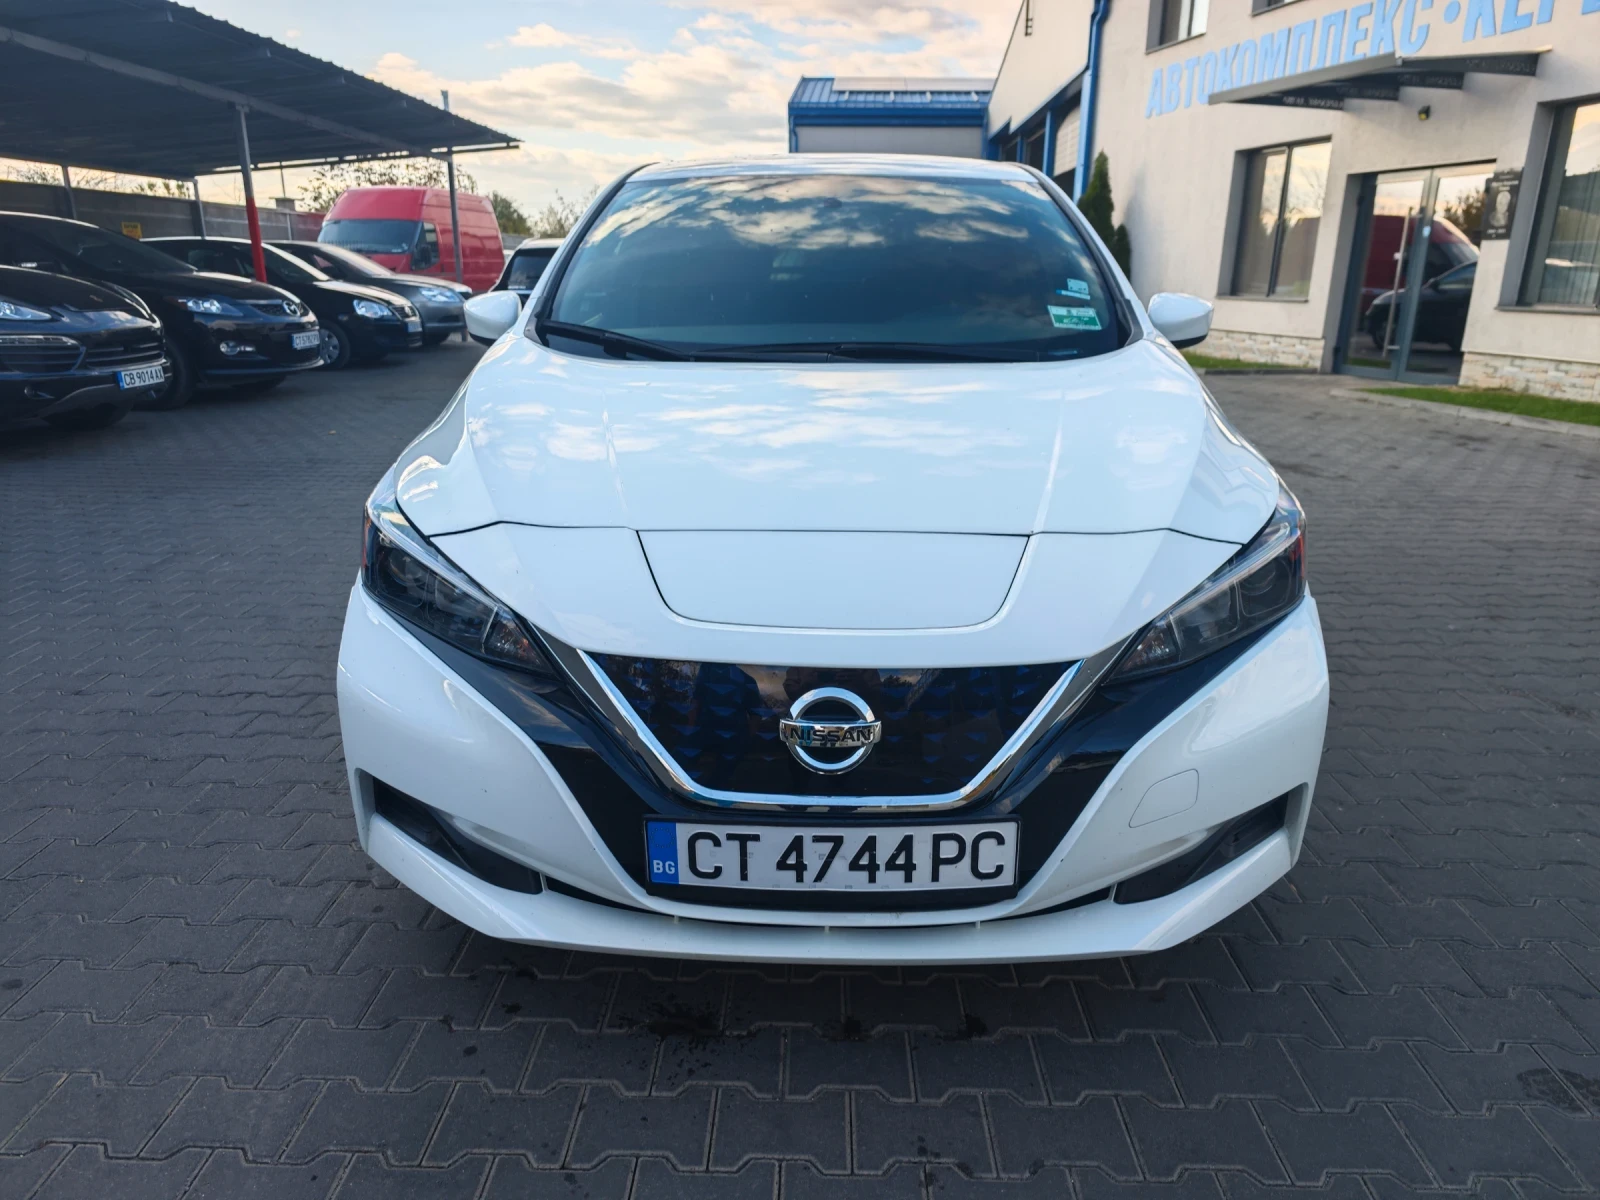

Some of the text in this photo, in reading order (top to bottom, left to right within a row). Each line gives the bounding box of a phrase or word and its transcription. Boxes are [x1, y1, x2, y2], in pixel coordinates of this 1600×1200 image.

[1144, 0, 1434, 119] АВТОКОМПЛЕКС
[124, 367, 164, 386] CB 9014 AX
[790, 727, 872, 742] NISSAN
[653, 859, 676, 875] BG
[687, 831, 1006, 884] CT 4744 PC
